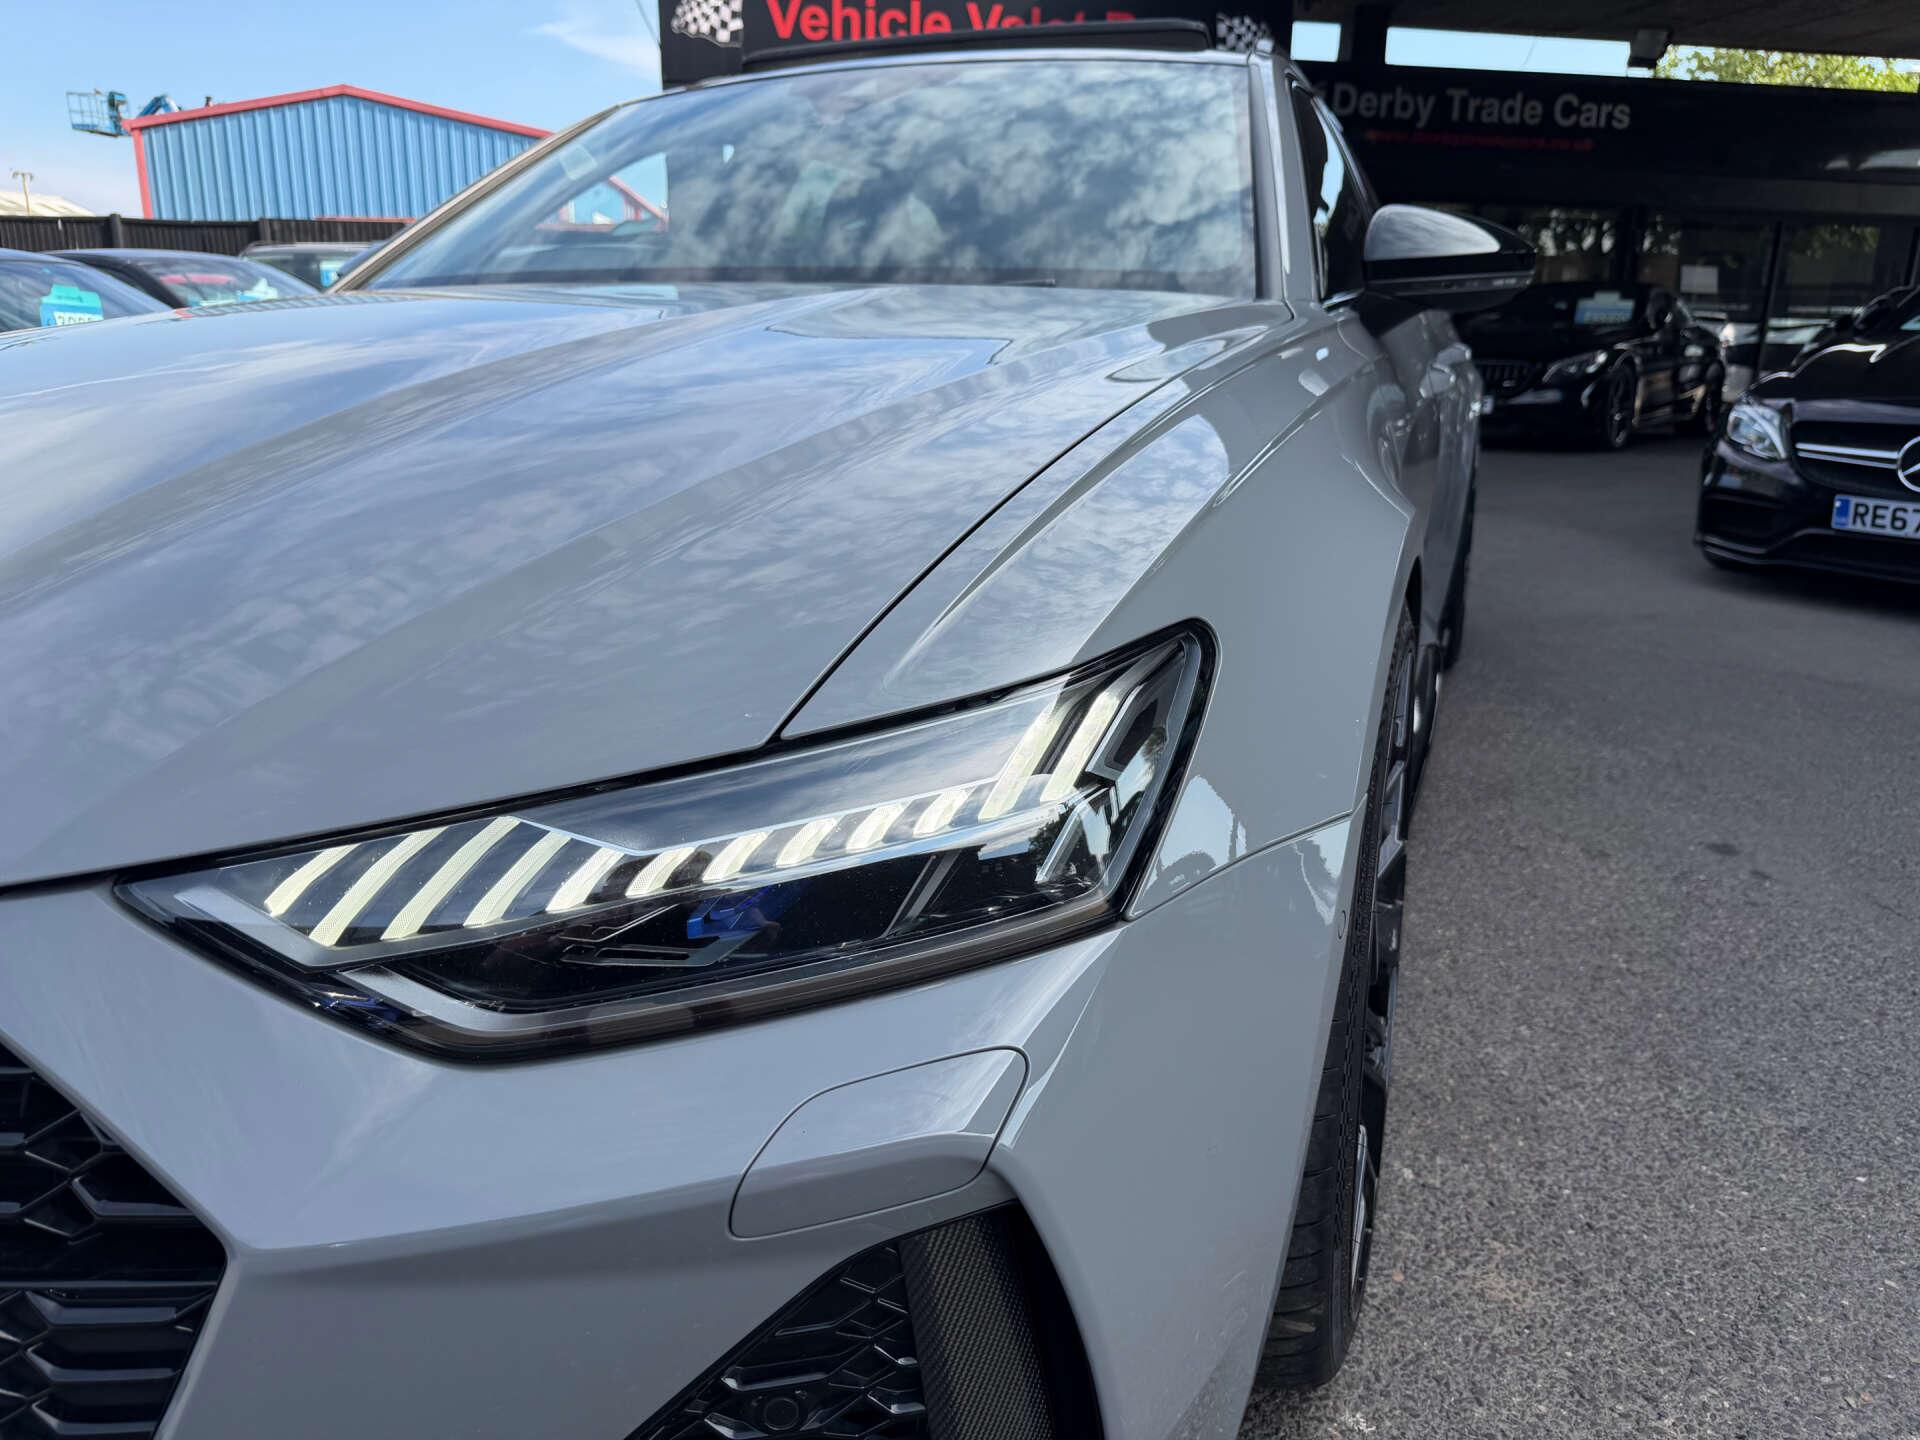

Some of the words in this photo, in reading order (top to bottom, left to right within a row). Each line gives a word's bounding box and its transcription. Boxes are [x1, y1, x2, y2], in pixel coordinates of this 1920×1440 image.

[766, 0, 952, 41] Vehicle
[1332, 82, 1436, 128] Derby
[1446, 88, 1543, 126] Trade
[1554, 93, 1632, 130] Cars
